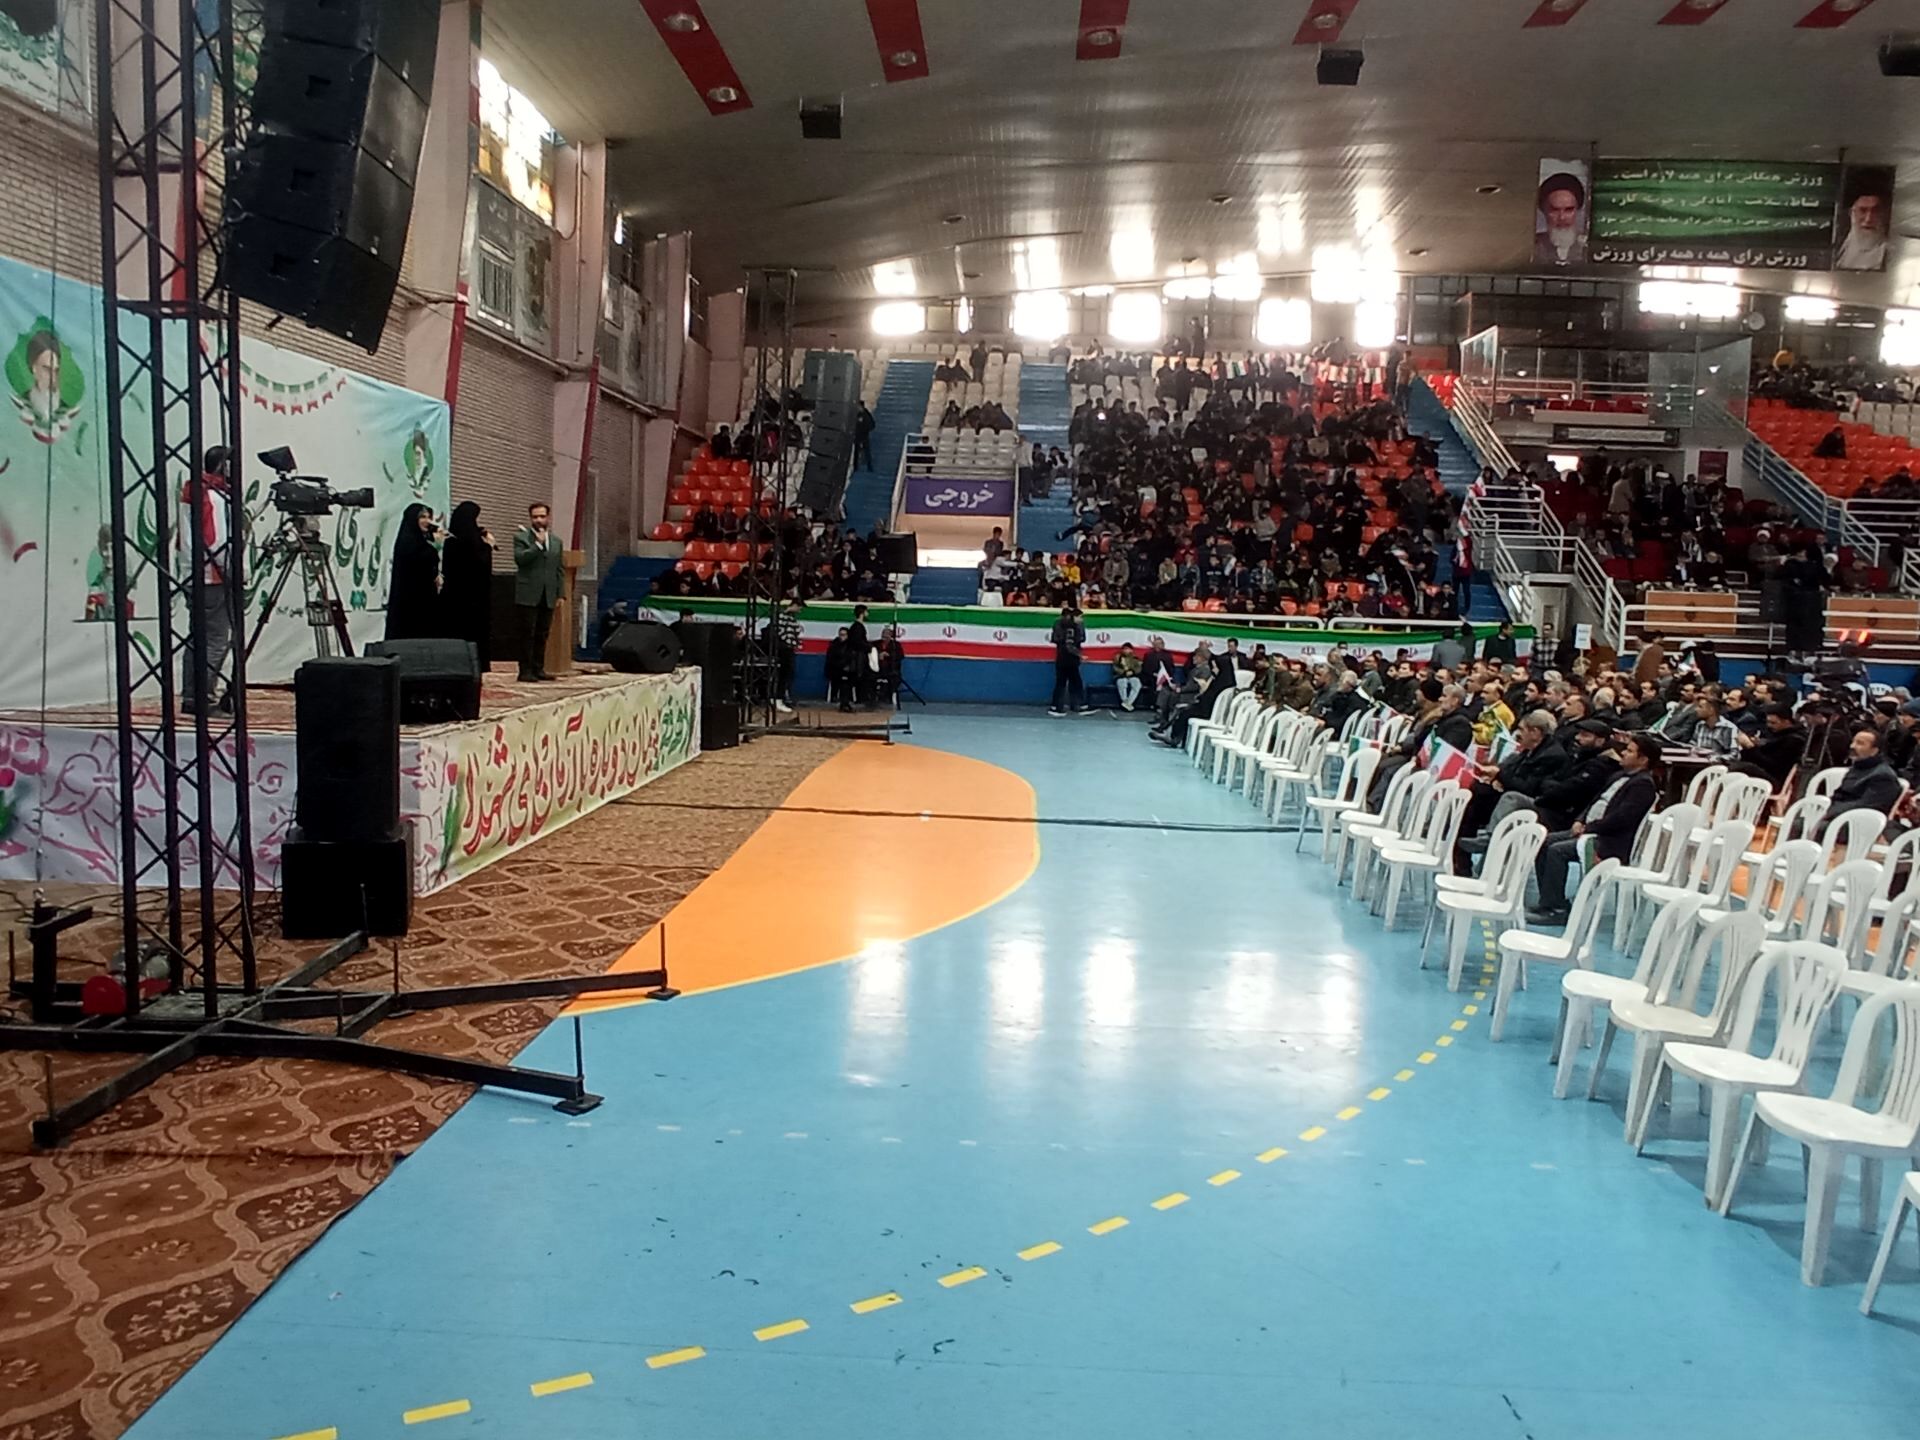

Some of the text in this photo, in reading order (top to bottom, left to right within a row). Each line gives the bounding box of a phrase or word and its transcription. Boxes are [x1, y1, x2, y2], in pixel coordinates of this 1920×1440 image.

[1784, 172, 1823, 187] ورزش
[1593, 245, 1634, 262] ورزش
[1637, 246, 1667, 262] برای
[1670, 250, 1694, 260] همه
[1733, 248, 1764, 266] برای
[1766, 249, 1807, 267] ورزش
[925, 483, 994, 508] خروجی
[463, 724, 516, 856] شهدا
